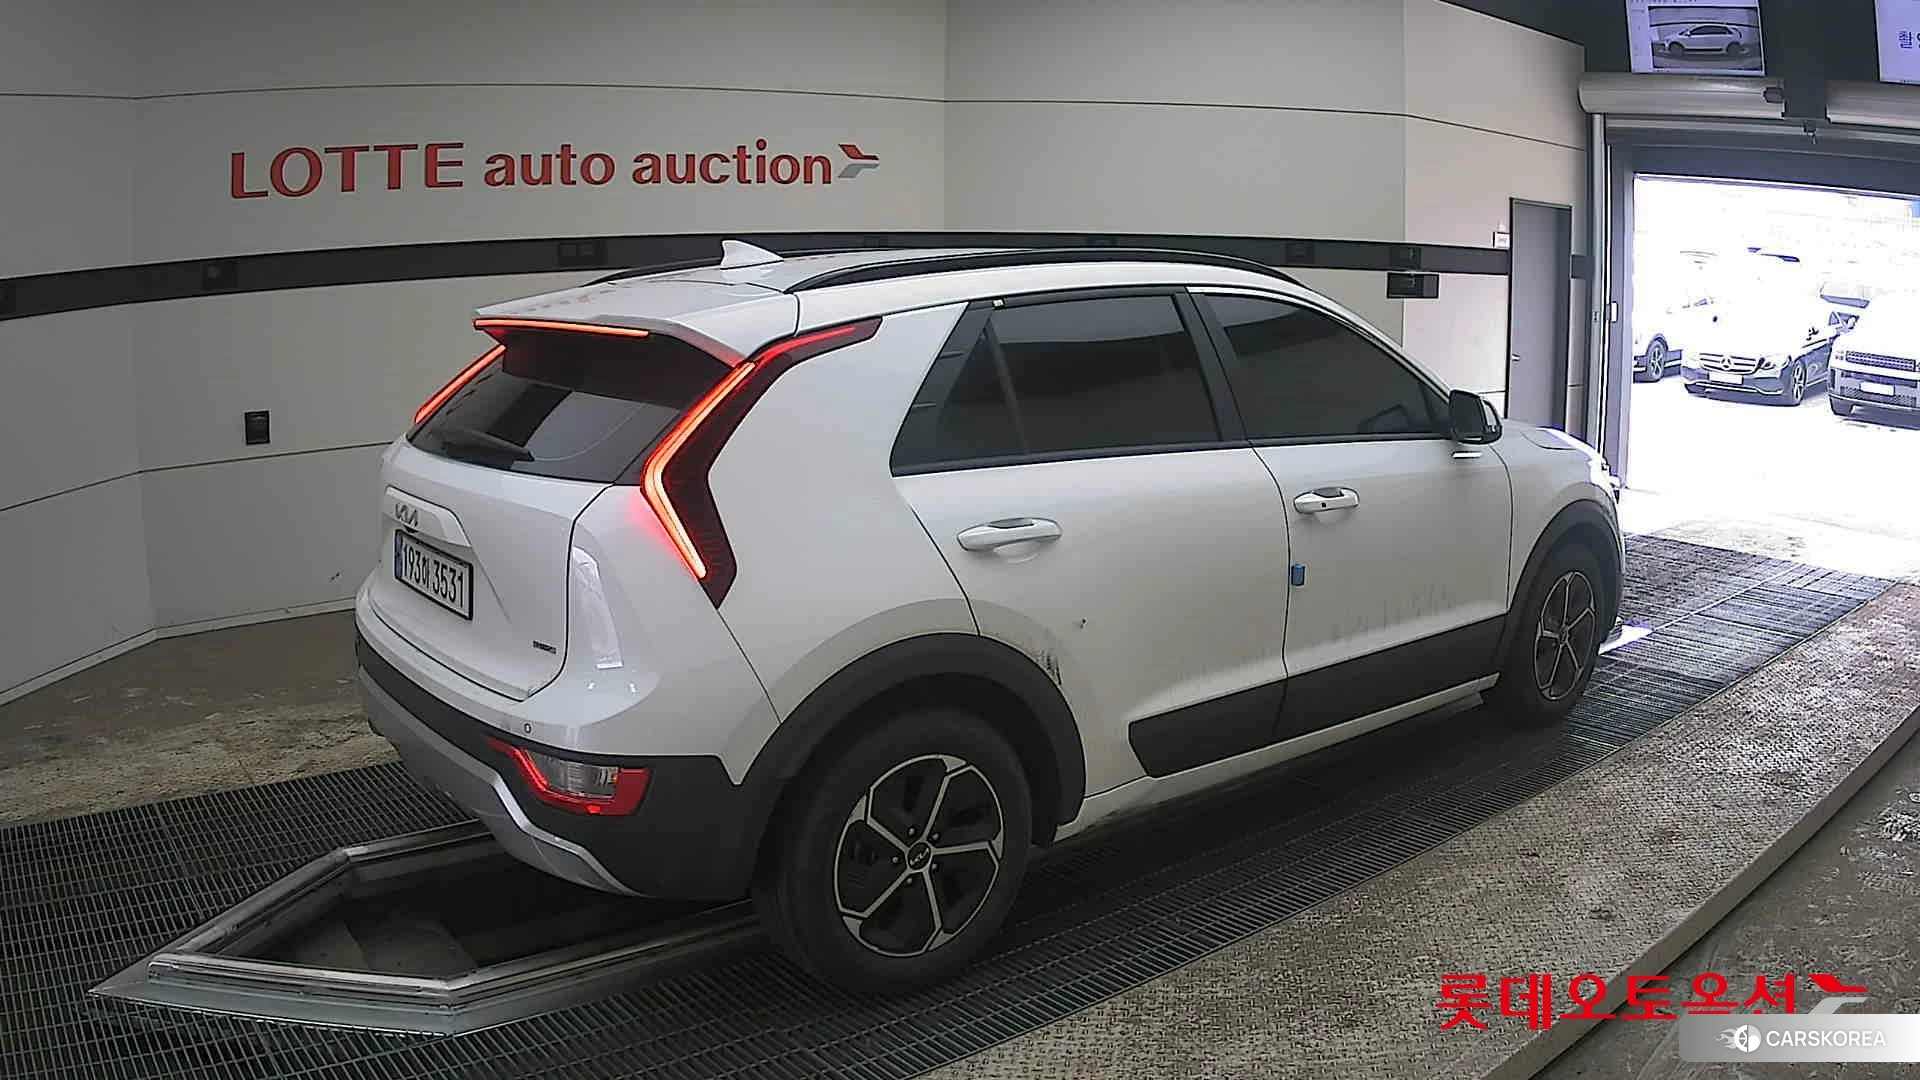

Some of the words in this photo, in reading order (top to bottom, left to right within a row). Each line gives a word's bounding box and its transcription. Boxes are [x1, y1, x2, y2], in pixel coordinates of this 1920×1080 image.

[231, 142, 465, 198] LOTTE
[483, 143, 616, 188] auto
[632, 139, 833, 186] auction
[432, 559, 464, 608] 3531
